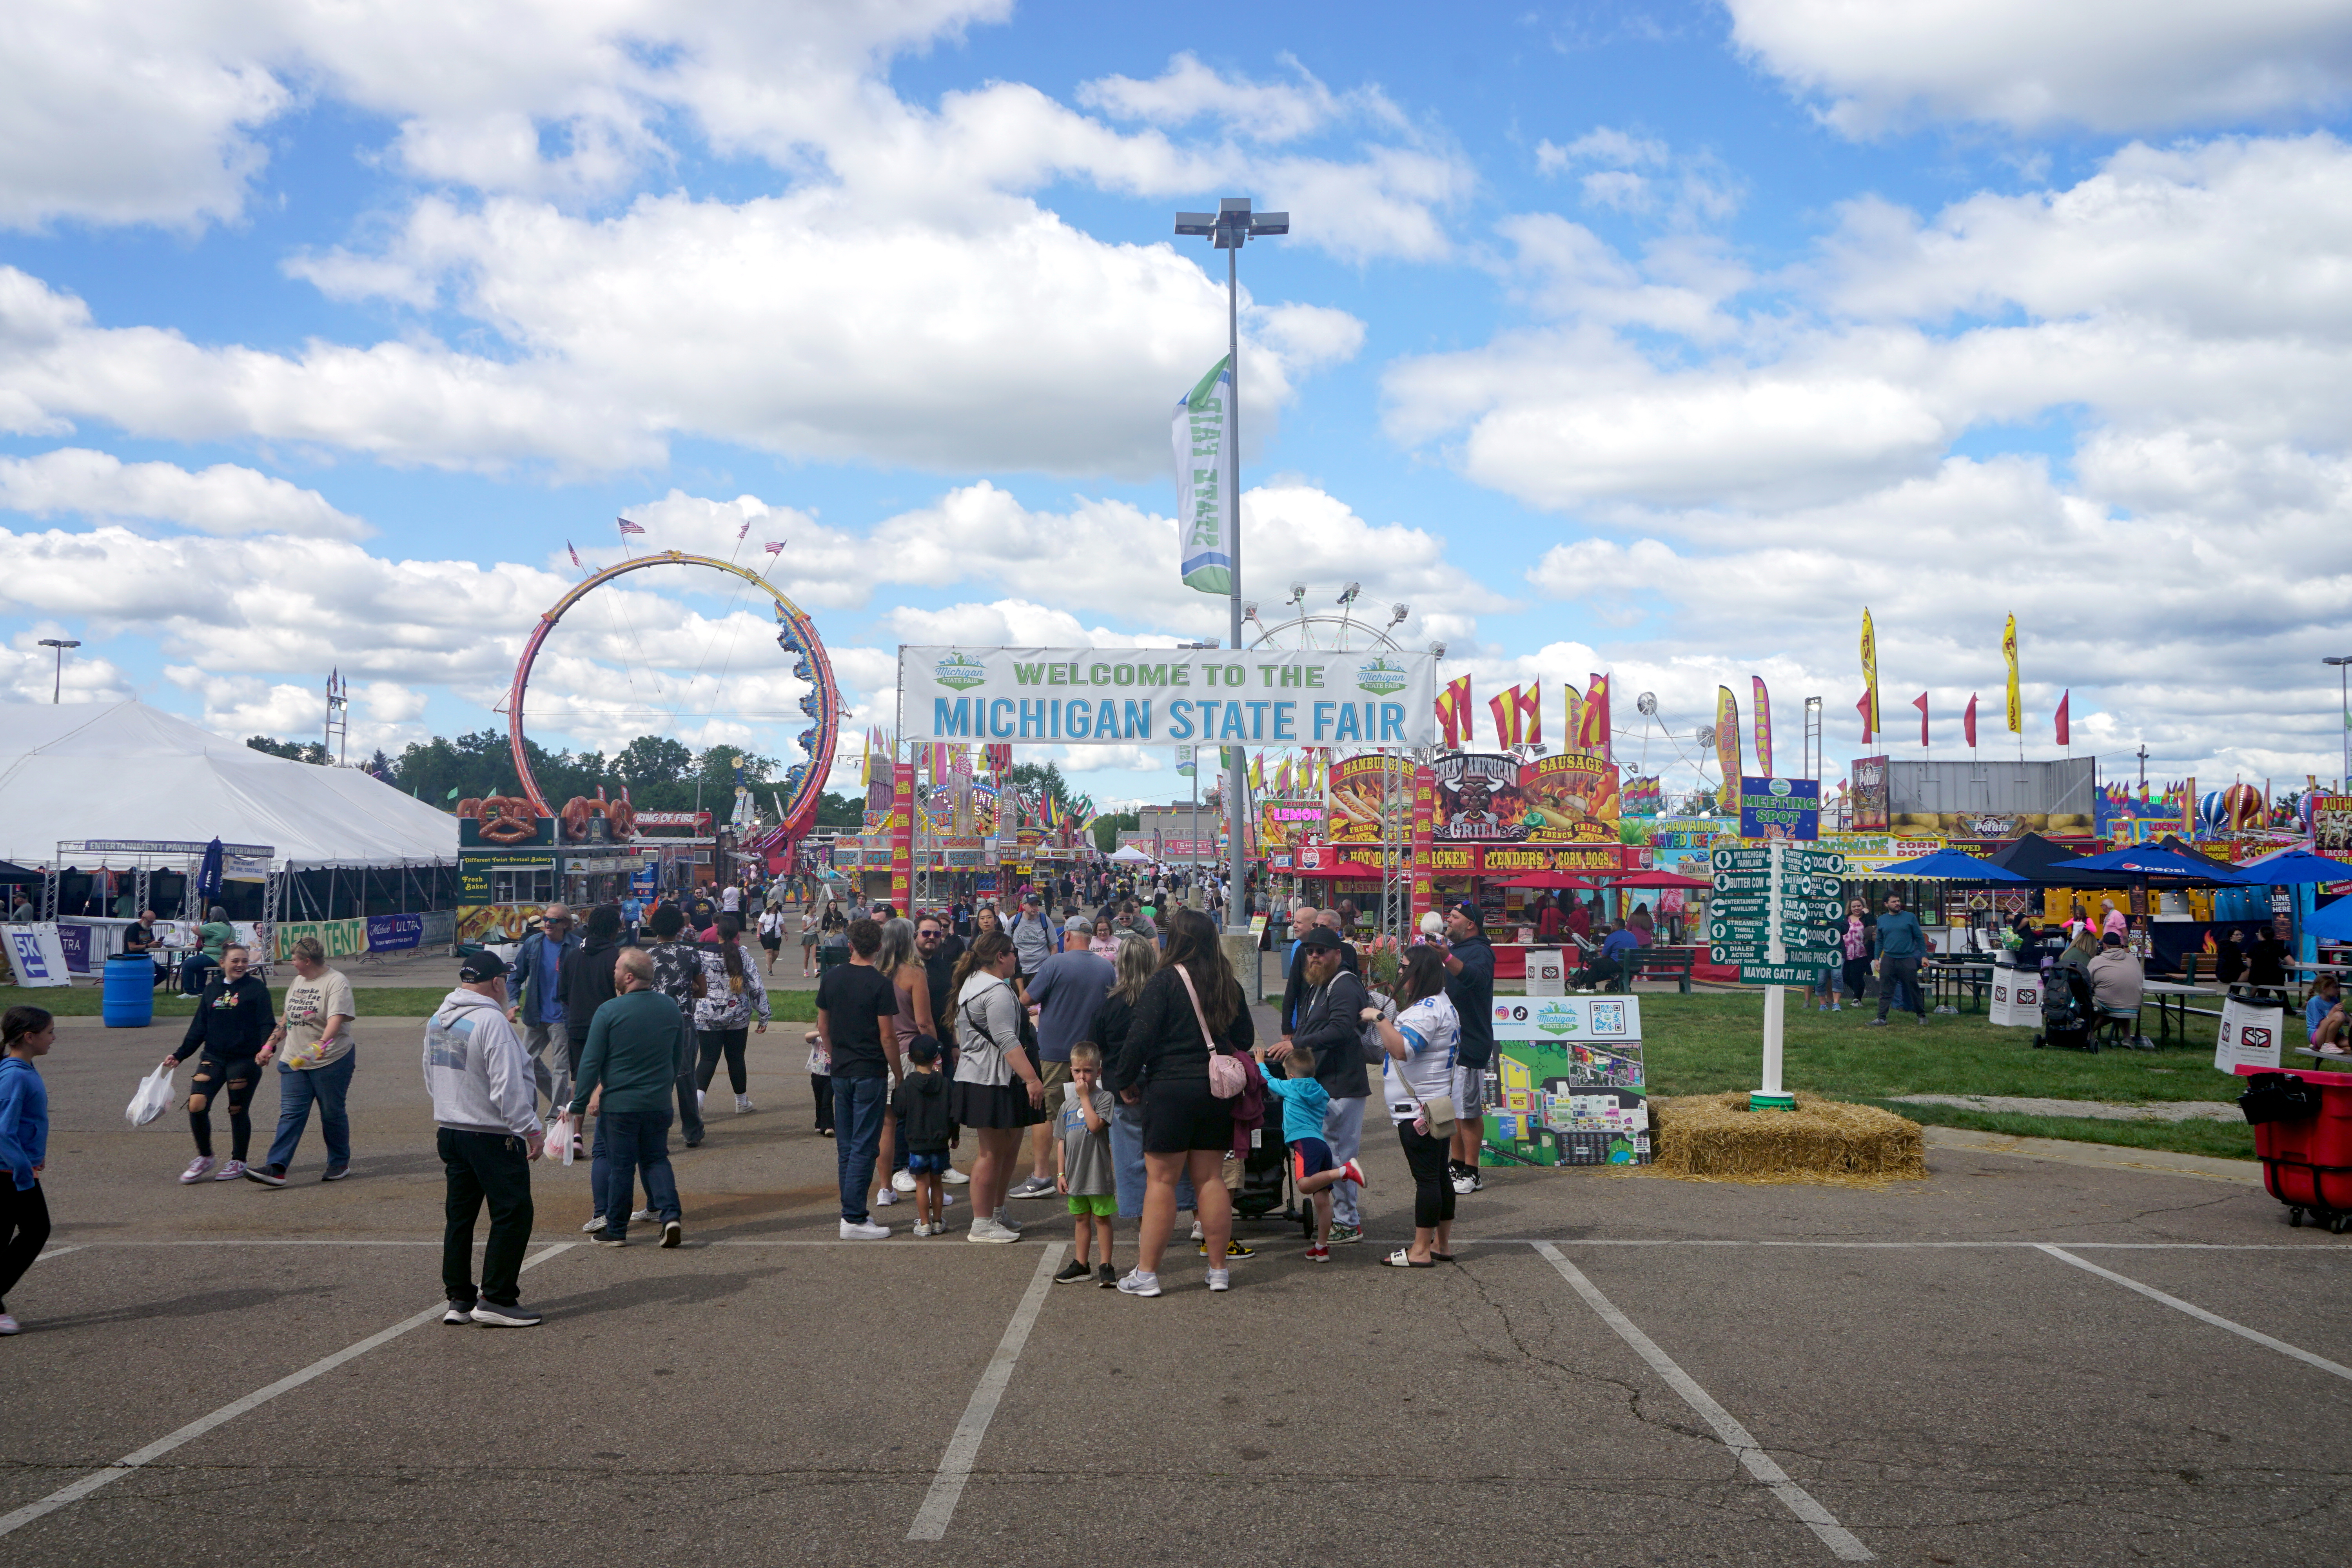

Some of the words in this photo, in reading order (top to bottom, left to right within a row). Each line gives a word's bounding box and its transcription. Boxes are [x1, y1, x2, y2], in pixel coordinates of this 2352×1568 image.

[935, 667, 984, 678] Michigan
[1014, 662, 1190, 686] WELCOME
[1201, 664, 1245, 687] TO
[1257, 664, 1325, 688] THE
[1357, 672, 1405, 683] Michigan
[933, 697, 1152, 740] MICHIGAN
[1168, 700, 1297, 741] STATE
[1313, 701, 1406, 742] FAIR
[1343, 757, 1414, 777] HAMBURGRS
[1539, 755, 1603, 774] SAUSAGE
[1434, 757, 1463, 786] GREAT
[1467, 756, 1517, 788] AMERICAN
[1859, 771, 1879, 786] Potato
[1742, 795, 1817, 810] MEETING
[2322, 798, 2352, 811] AUTH
[636, 814, 659, 823] RING
[660, 813, 673, 823] OF
[675, 813, 696, 823] FIRE
[1274, 808, 1324, 821] LEMON
[1756, 809, 1800, 824] SPOT
[1349, 824, 1379, 834] FRENCH
[1450, 820, 1501, 838] GRILL
[1574, 824, 1602, 834] FRIES
[1665, 819, 1720, 833] HAWAIIAN
[1786, 824, 1795, 838] 2
[1975, 819, 2009, 832] Potato
[2149, 822, 2181, 831] LUCKY
[1381, 831, 1410, 839] FRIS
[1542, 830, 1573, 839] FRENCH
[1644, 833, 1687, 847] SHAVED
[1691, 833, 1708, 848] ICE
[90, 842, 163, 851] ENTERTAINMENT
[165, 843, 207, 852] PAVILION
[1803, 838, 1889, 855] LEMONADE
[867, 853, 891, 863] COTT
[1350, 851, 1370, 864] HOT
[1490, 851, 1544, 865] TENDERS
[1558, 852, 1581, 865] CORN
[1586, 852, 1609, 866] DOGS
[1742, 850, 1765, 859] MICHIGAN
[1786, 850, 1803, 859] CONTEST
[1737, 858, 1762, 867] FARMLAND
[1786, 857, 1803, 866] CENTRAL
[1788, 864, 1800, 872] STAGE
[1730, 877, 1751, 889] BUTTER
[1751, 877, 1764, 888] COW
[1784, 874, 1793, 884] Rock
[1793, 875, 1795, 884] N
[2332, 885, 2350, 893] MEXICAN
[1785, 899, 1798, 910] FAIR
[959, 911, 969, 922] 16
[1783, 909, 1800, 920] OFFICE
[370, 924, 391, 936] Michelob
[396, 920, 421, 932] ULTRA
[324, 921, 359, 957] TENT
[15, 936, 40, 958] 5K
[1790, 951, 1812, 963] RACING
[1813, 952, 1827, 964] PIGS
[466, 966, 480, 975] FORGET
[1744, 966, 1771, 979] MAYOR
[1773, 968, 1795, 980] GATT
[1796, 969, 1815, 981] AVE.
[1413, 998, 1436, 1007] 26
[1536, 1014, 1577, 1023] Michigan
